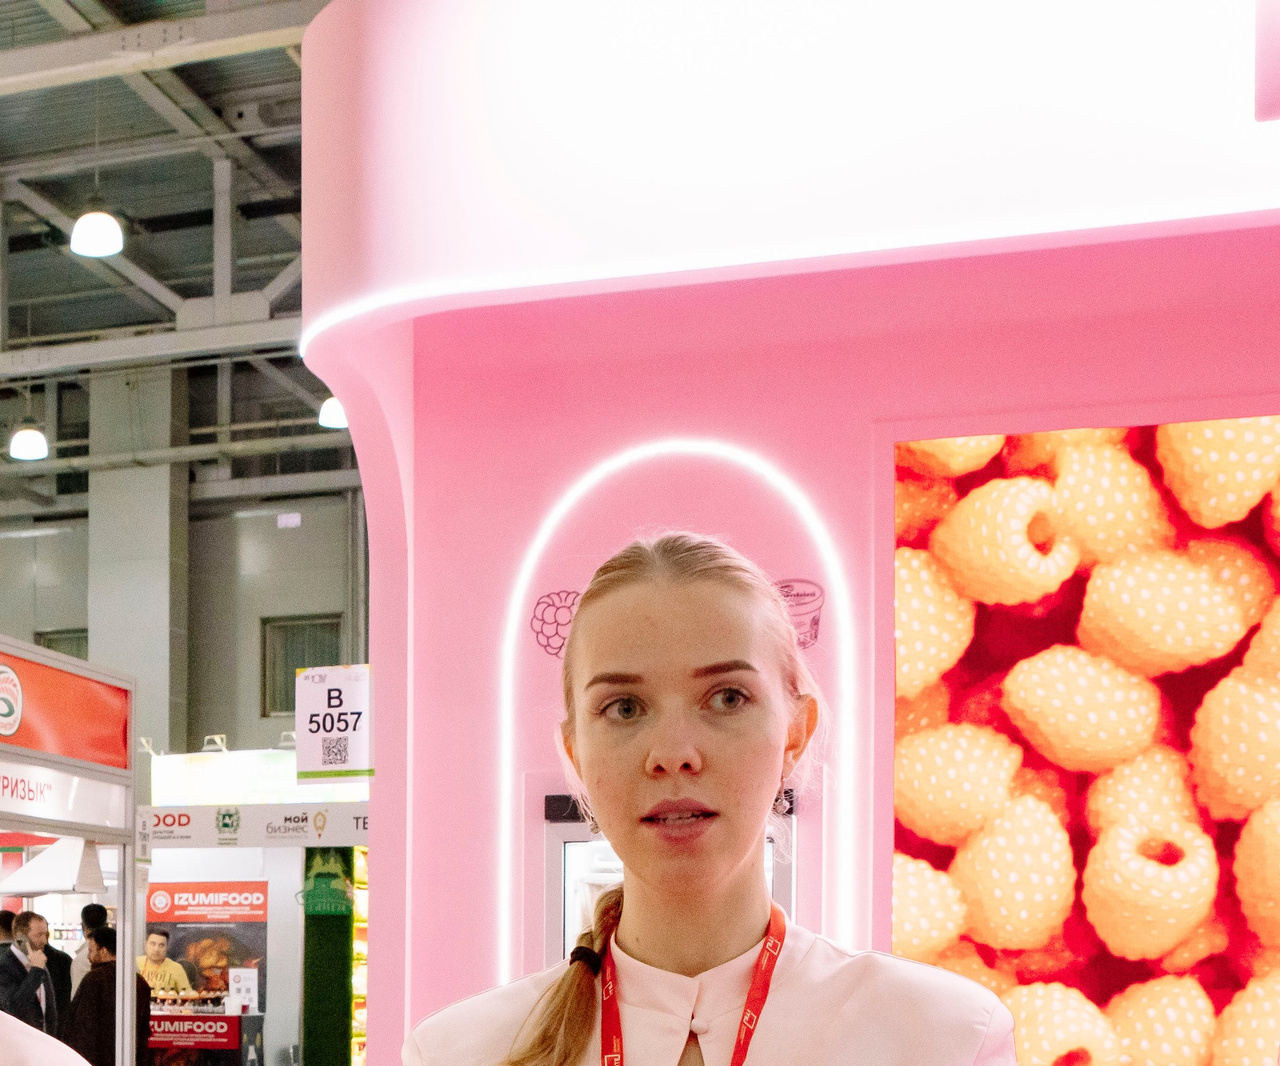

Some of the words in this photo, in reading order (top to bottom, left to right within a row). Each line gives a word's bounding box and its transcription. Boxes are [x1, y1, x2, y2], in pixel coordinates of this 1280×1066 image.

[326, 687, 344, 708] B
[308, 711, 363, 734] 5057
[284, 811, 309, 824] мой
[265, 822, 309, 834] бизнес
[173, 892, 265, 906] IZUMIFOOD
